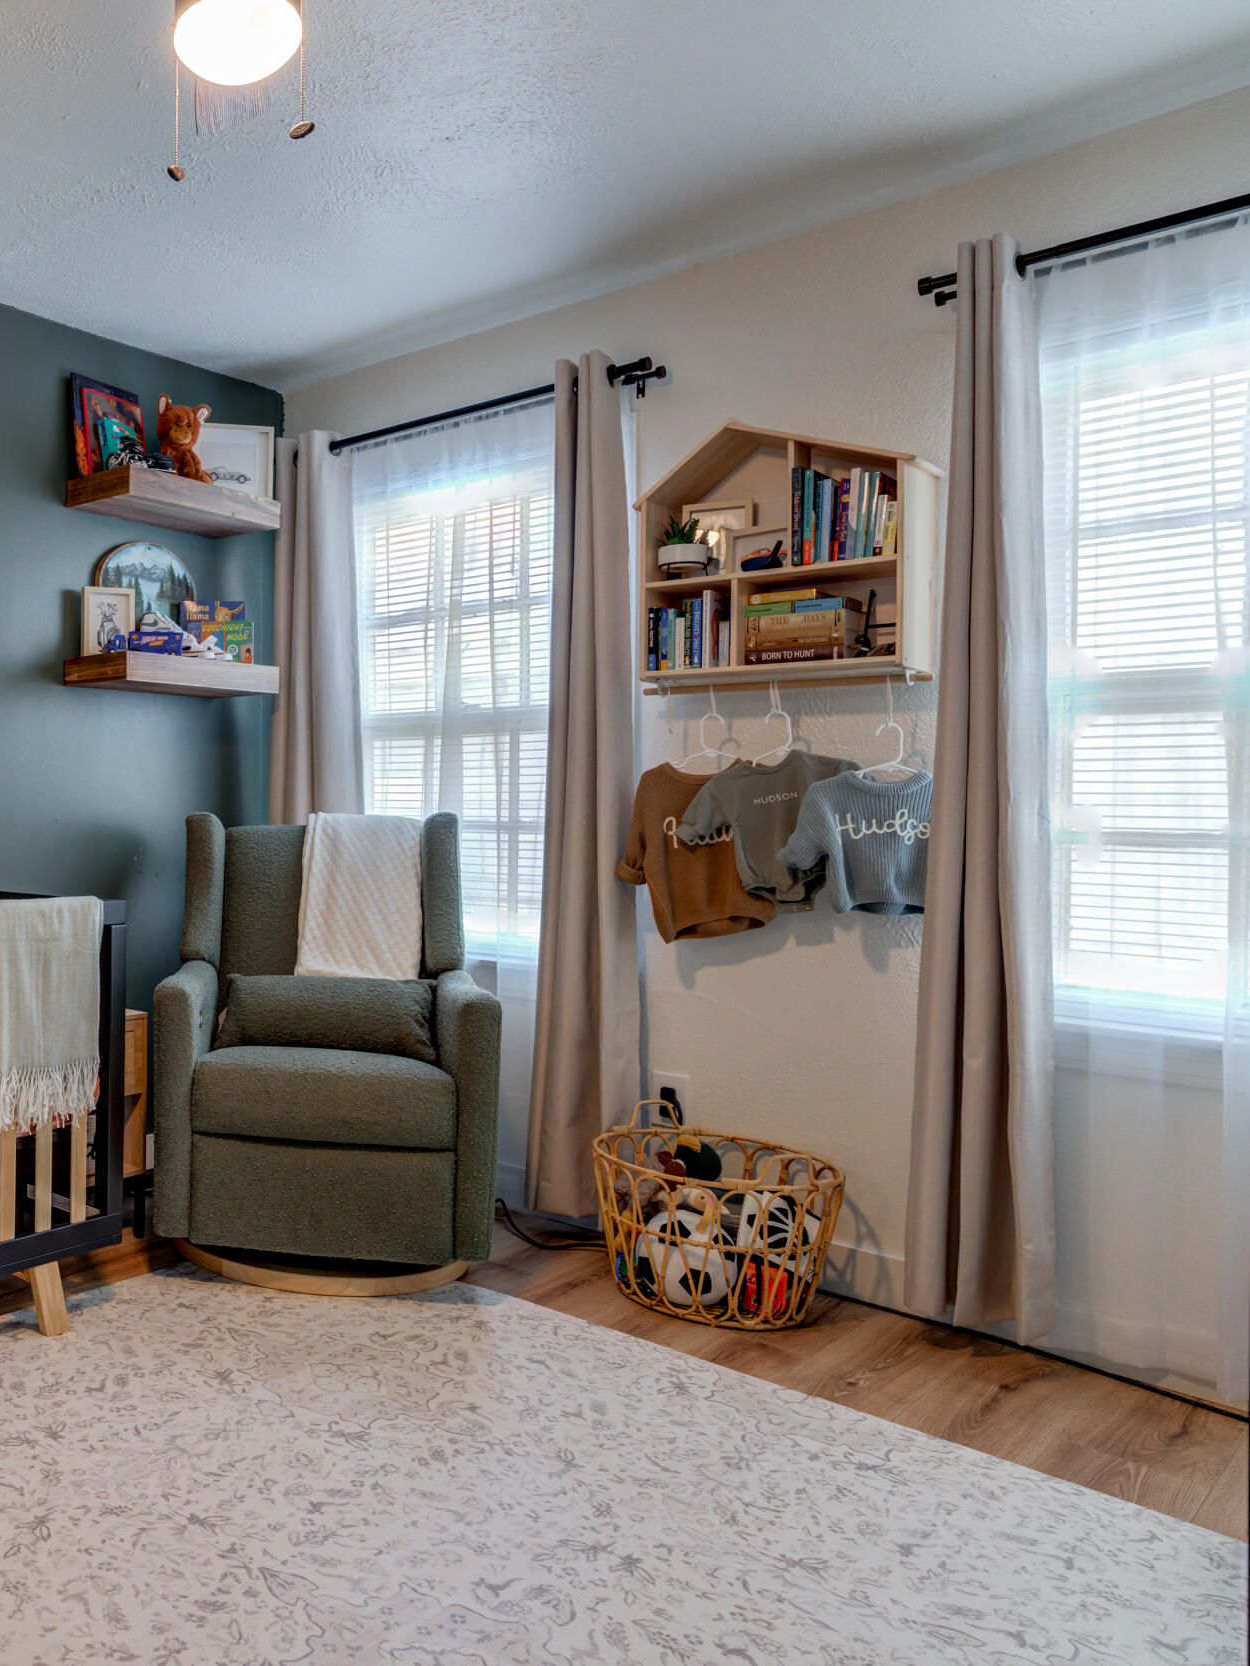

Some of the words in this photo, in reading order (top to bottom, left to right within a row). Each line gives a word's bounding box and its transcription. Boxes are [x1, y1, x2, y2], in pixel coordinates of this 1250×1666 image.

[201, 623, 243, 632] GOODNIGHT
[226, 633, 248, 641] MOON
[761, 651, 781, 660] BORN
[783, 650, 793, 659] TO
[794, 649, 815, 658] HUNT
[753, 791, 798, 806] HUDSON
[835, 808, 931, 845] Hudso
